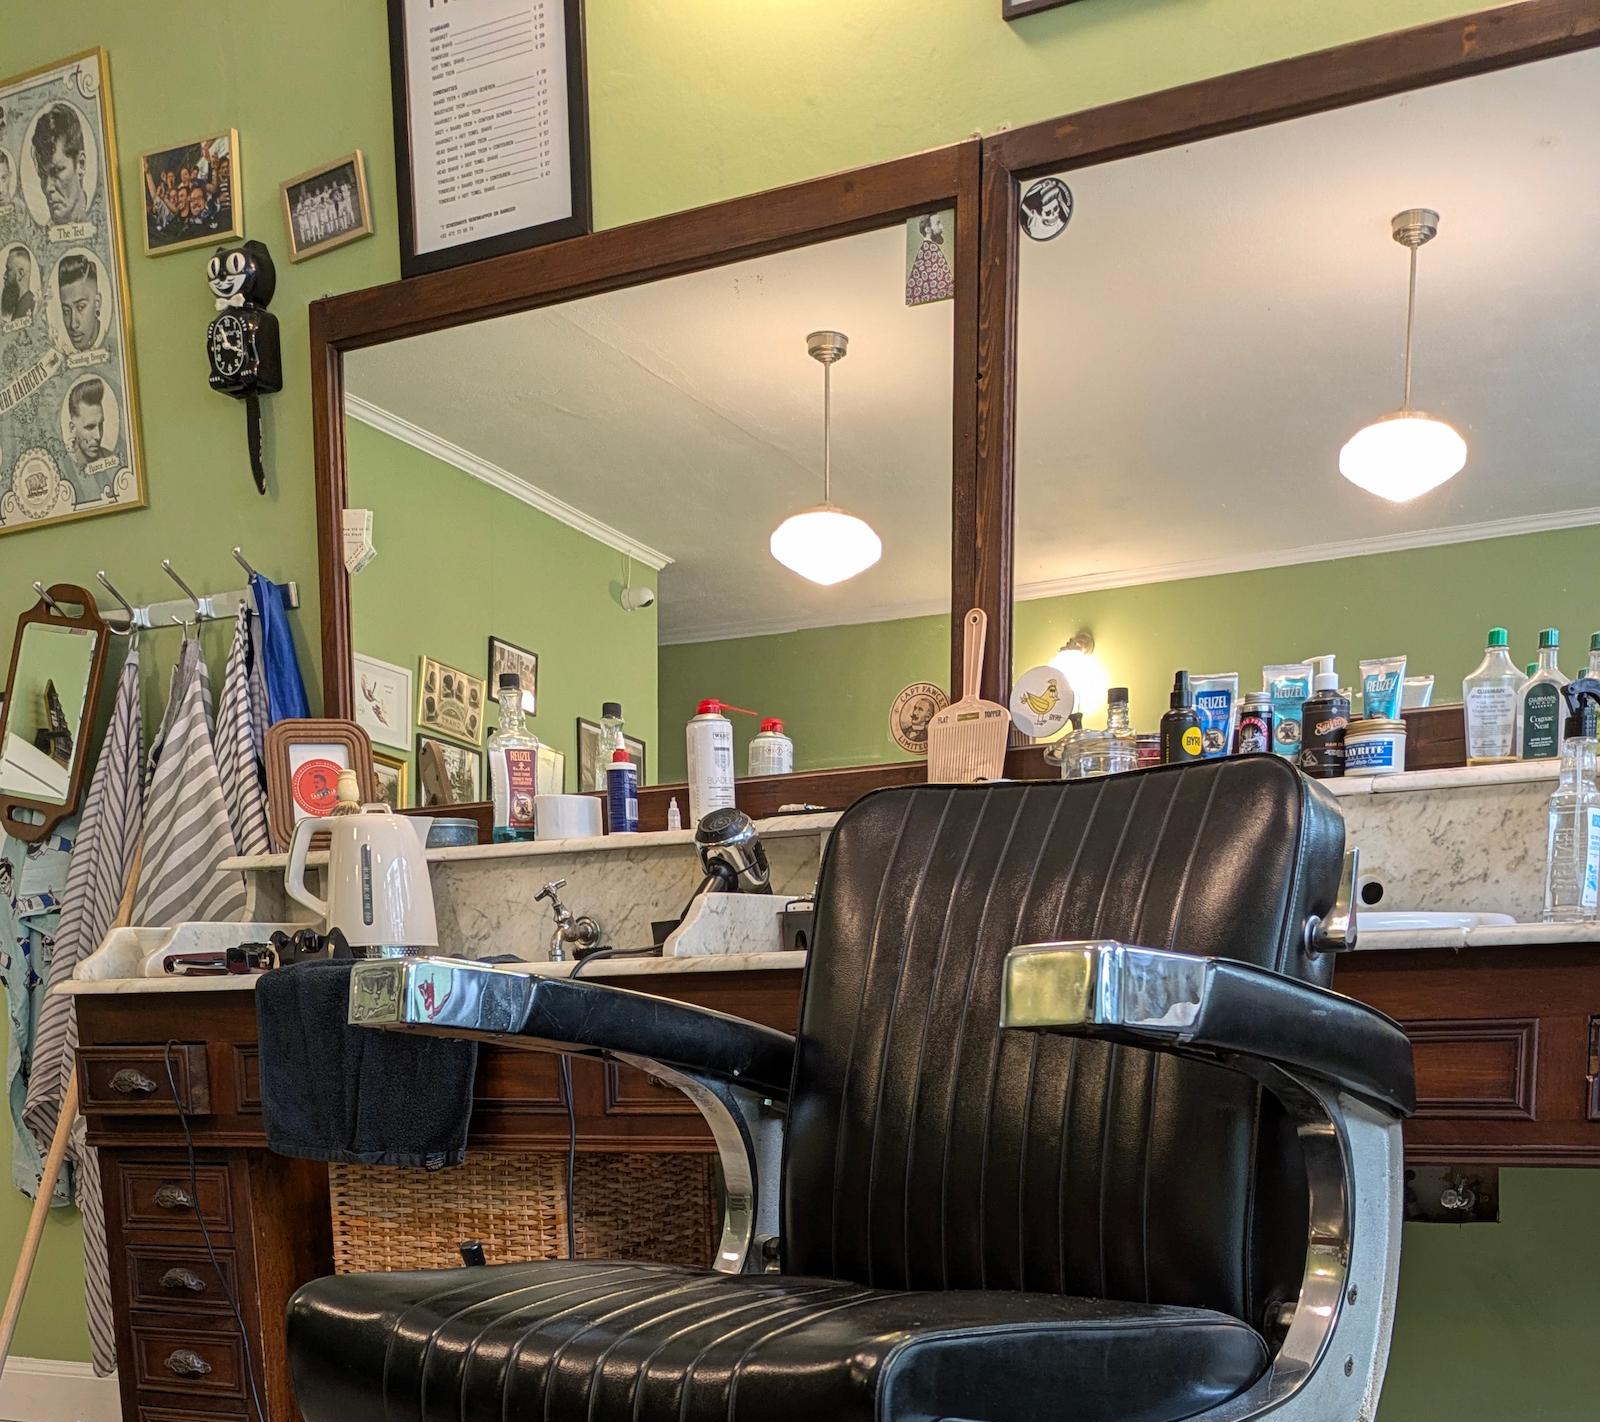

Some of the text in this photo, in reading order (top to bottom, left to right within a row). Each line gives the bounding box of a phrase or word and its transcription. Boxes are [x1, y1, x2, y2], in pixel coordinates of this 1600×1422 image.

[56, 227, 70, 239] The
[12, 361, 48, 402] HAIRCUTS
[900, 685, 948, 709] CAPT FAWCET
[1274, 686, 1304, 699] REUZEL
[1198, 696, 1228, 709] REUZEL
[1530, 715, 1553, 724] Cognac
[898, 735, 928, 751] LIMITED
[1186, 736, 1200, 746] BYR
[510, 750, 532, 762] REUZEL
